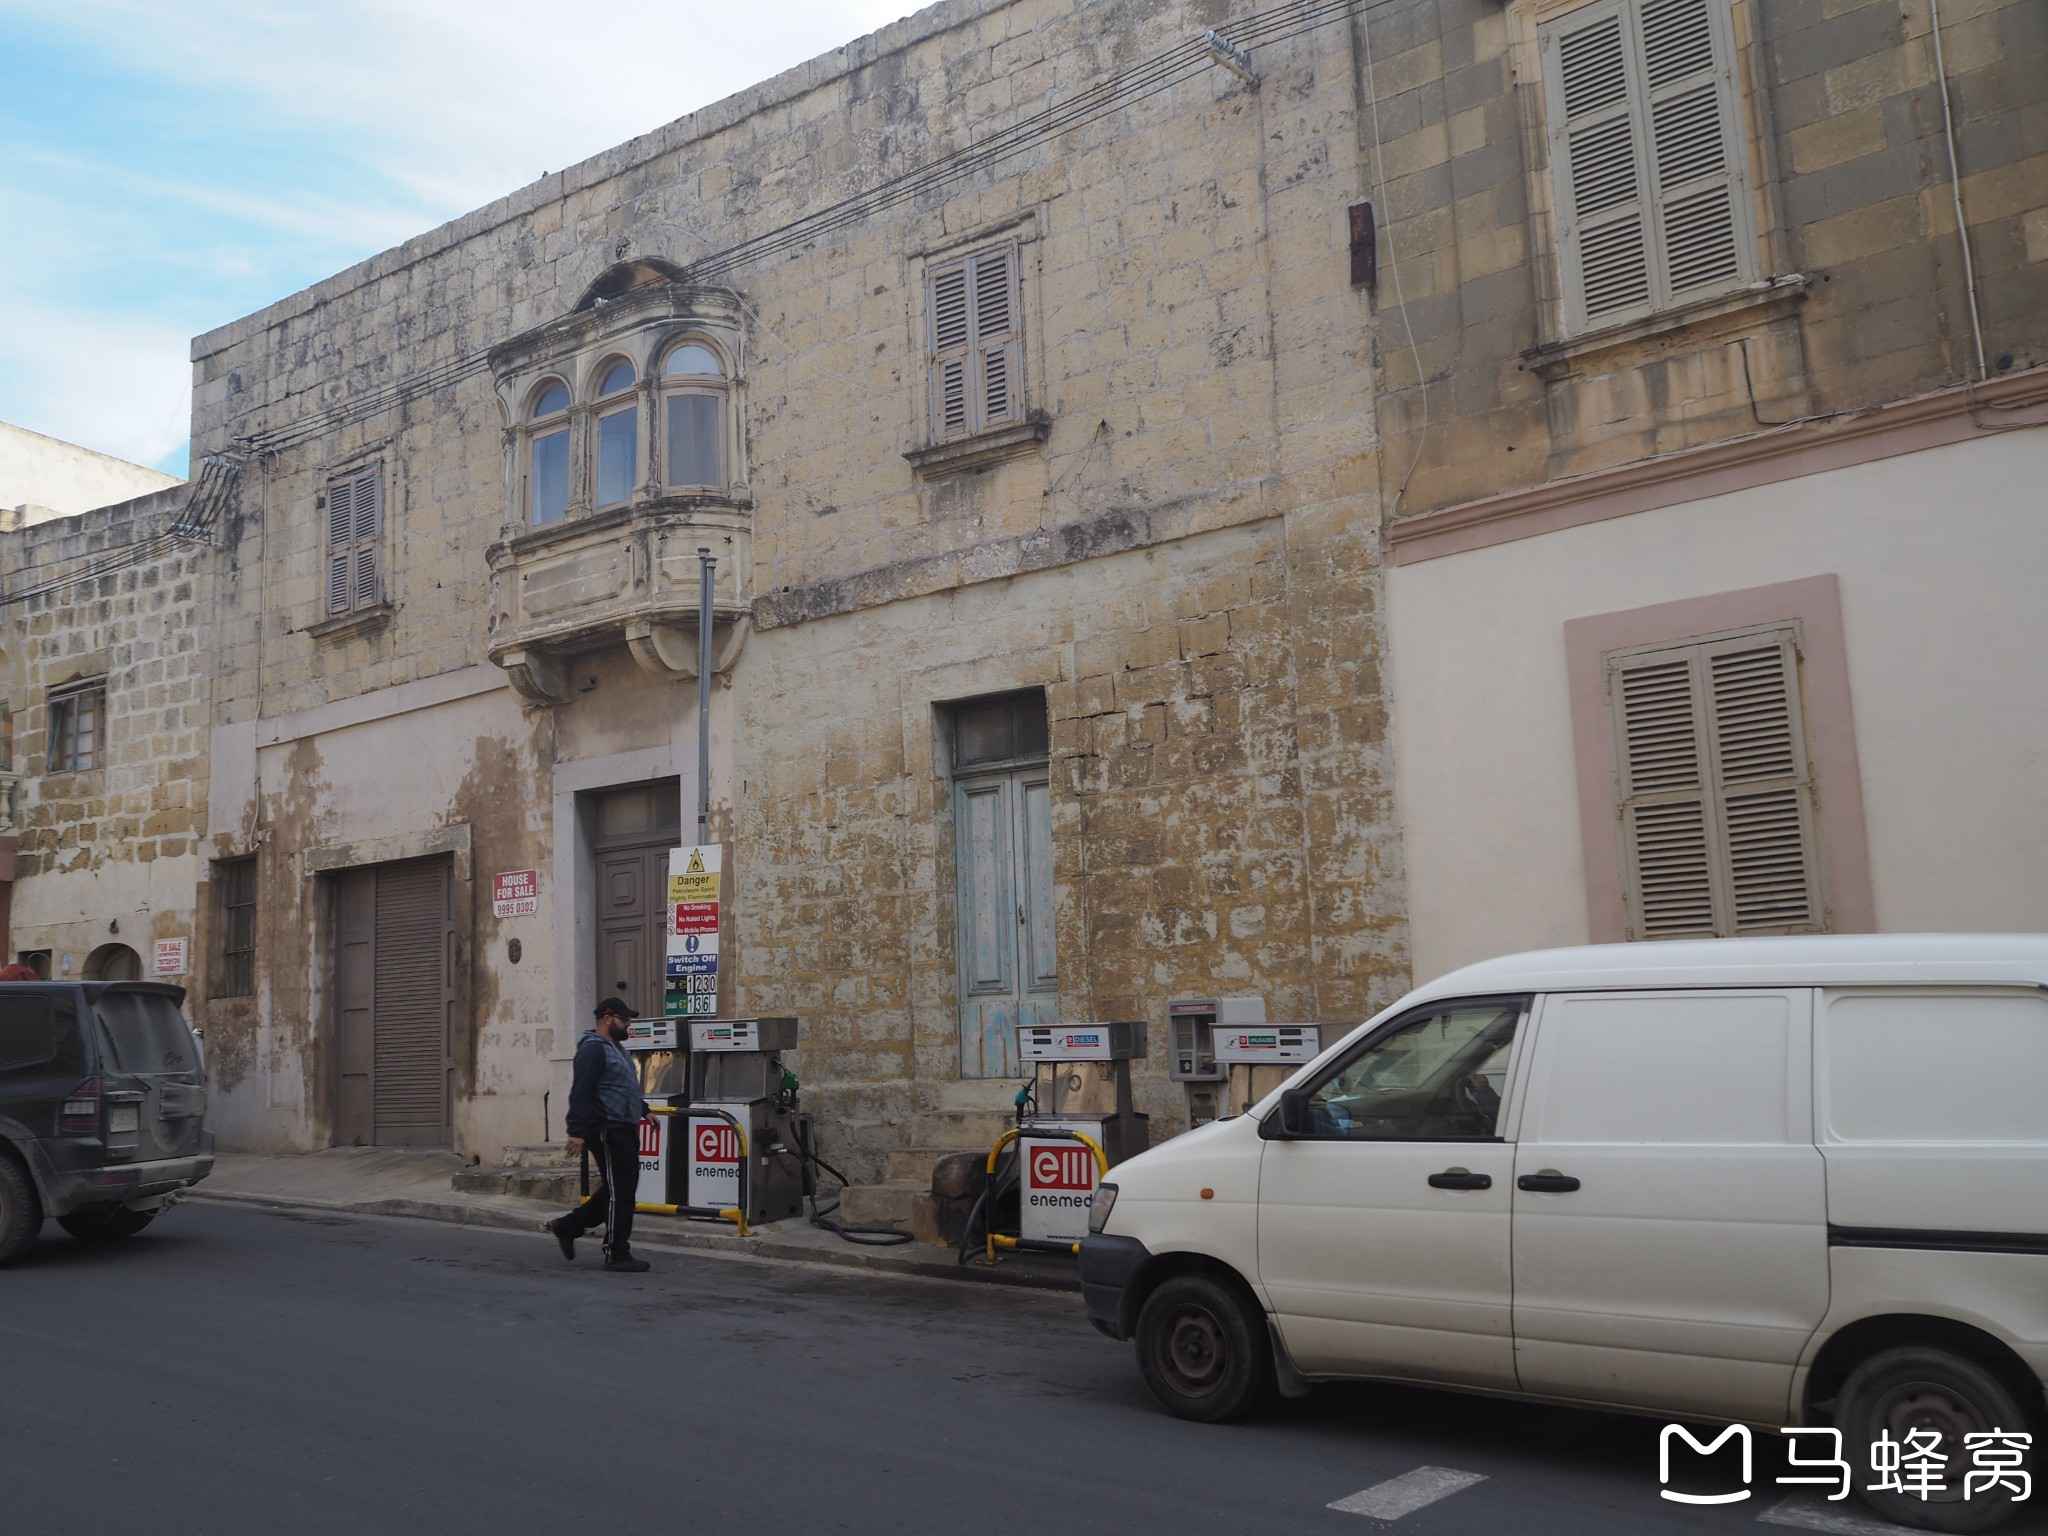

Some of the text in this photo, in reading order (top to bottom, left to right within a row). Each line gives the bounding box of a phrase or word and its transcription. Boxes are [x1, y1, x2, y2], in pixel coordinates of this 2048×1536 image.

[502, 873, 529, 887] HOUSE
[677, 876, 709, 887] Danger
[496, 885, 534, 899] FOR SALE
[668, 954, 717, 964] Switch Off
[675, 964, 707, 973] Engine
[1030, 1194, 1093, 1208] enemed
